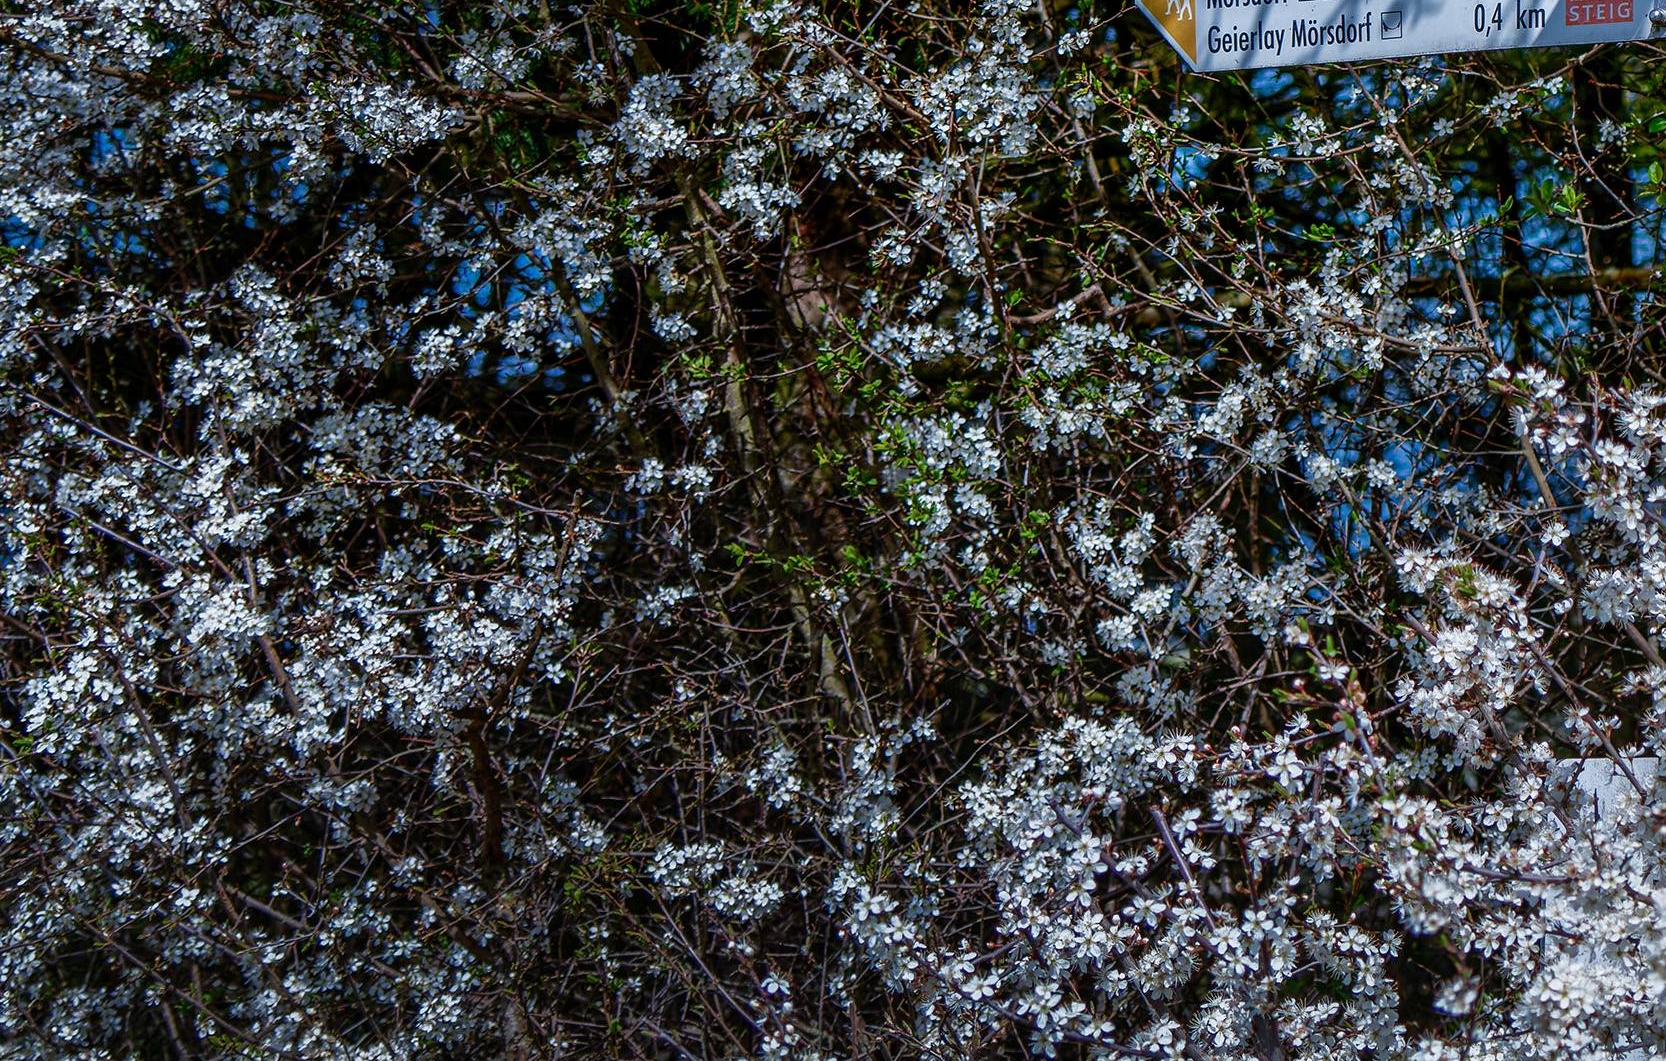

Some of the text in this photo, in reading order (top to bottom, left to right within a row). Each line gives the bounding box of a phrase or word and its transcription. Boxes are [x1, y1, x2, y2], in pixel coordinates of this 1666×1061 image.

[1207, 22, 1285, 56] Geierlay
[1291, 11, 1372, 48] Mörsdorf
[1473, 1, 1504, 38] 0,4
[1569, 2, 1632, 23] STEIG
